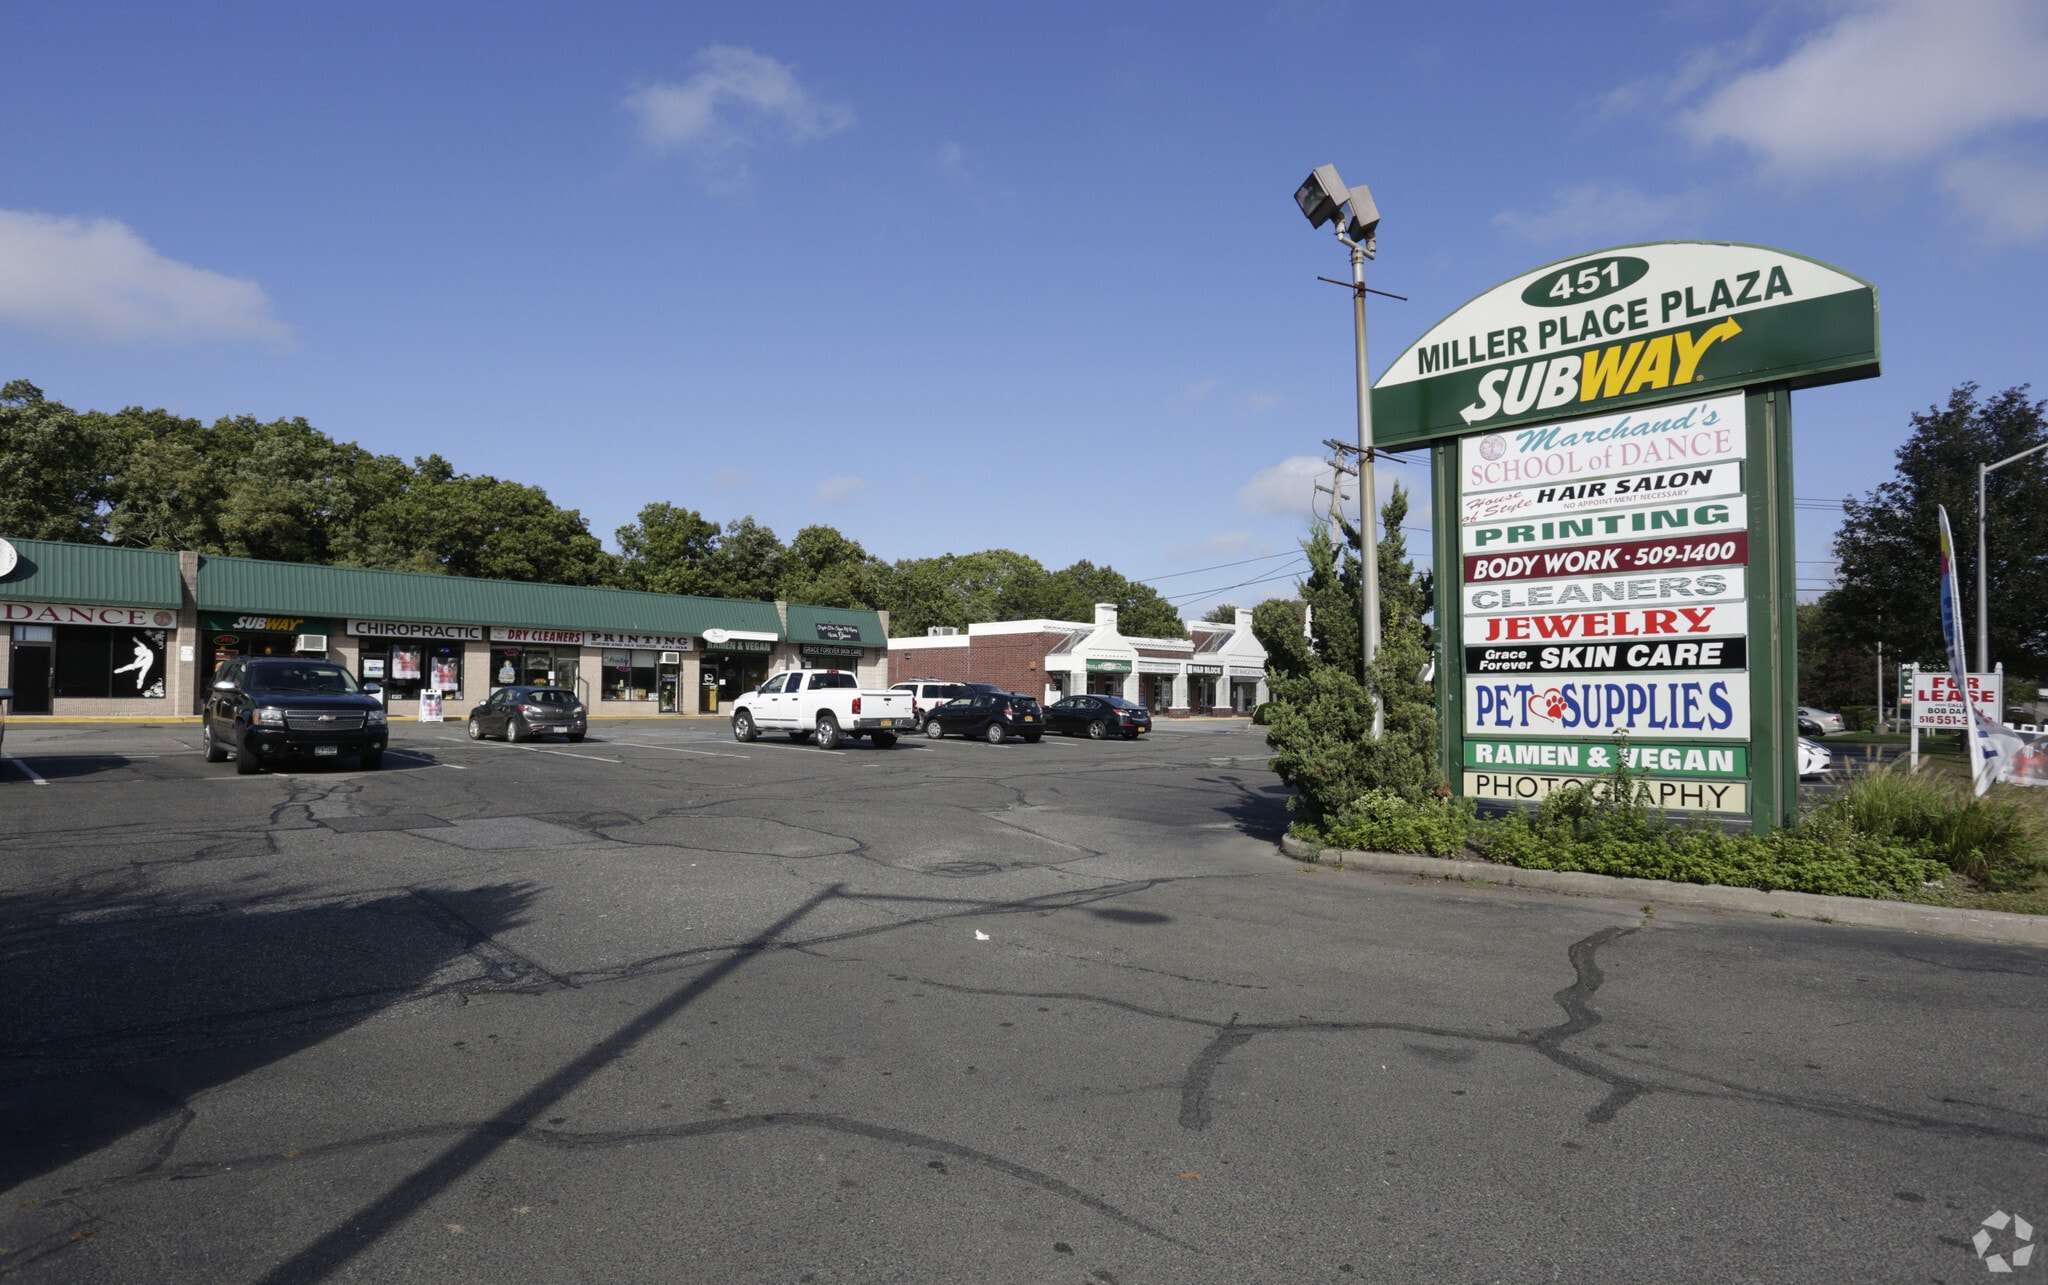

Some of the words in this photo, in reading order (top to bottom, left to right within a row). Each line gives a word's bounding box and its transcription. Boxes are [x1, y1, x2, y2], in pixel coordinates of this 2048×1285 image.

[1549, 260, 1621, 301] 451
[1418, 325, 1528, 375] MILLER
[1539, 298, 1649, 350] PLACE
[1661, 264, 1794, 323] PLAZA
[1459, 316, 1743, 425] SUBWAY
[1515, 403, 1721, 453] Marchand's
[1471, 452, 1582, 486] SCHOOL
[1588, 444, 1613, 471] of
[1620, 429, 1733, 467] DANCE
[1537, 482, 1606, 503] HAIR
[1615, 469, 1713, 494] SALON
[1462, 512, 1478, 523] of
[1483, 499, 1533, 517] Style
[1466, 491, 1523, 510] House
[1563, 501, 1576, 509] NO
[1578, 495, 1638, 508] APPOINTMENT
[1640, 489, 1689, 502] NECESSARY
[1475, 504, 1729, 547] PRINTING
[1473, 555, 1540, 580] BODY
[1544, 548, 1623, 574] WORK
[1633, 541, 1737, 566] 509-1400
[1471, 574, 1727, 610] CLEANERS
[2, 603, 147, 626] DANCE
[232, 616, 304, 631] SUBWAY
[1485, 607, 1716, 641] JEWELRY
[355, 622, 480, 639] CHIROPRACTIC
[508, 629, 530, 641] DRY
[532, 630, 581, 643] CLEANERS
[591, 632, 688, 646] PRINTING
[737, 641, 744, 651] &
[745, 641, 771, 651] VEGAN
[1485, 649, 1527, 660] Grace
[1540, 645, 1618, 670] SKIN
[1626, 642, 1724, 667] CARE
[1479, 659, 1533, 671] Forever
[1932, 677, 1979, 689] FOR
[1475, 683, 1535, 729] PET
[1561, 681, 1733, 731] SUPPLIES
[1918, 690, 1995, 702] LEASE
[1919, 715, 1935, 723] 516
[1475, 743, 1579, 768] RAMEN
[1587, 746, 1612, 768] &
[1620, 747, 1734, 772] VEGAN
